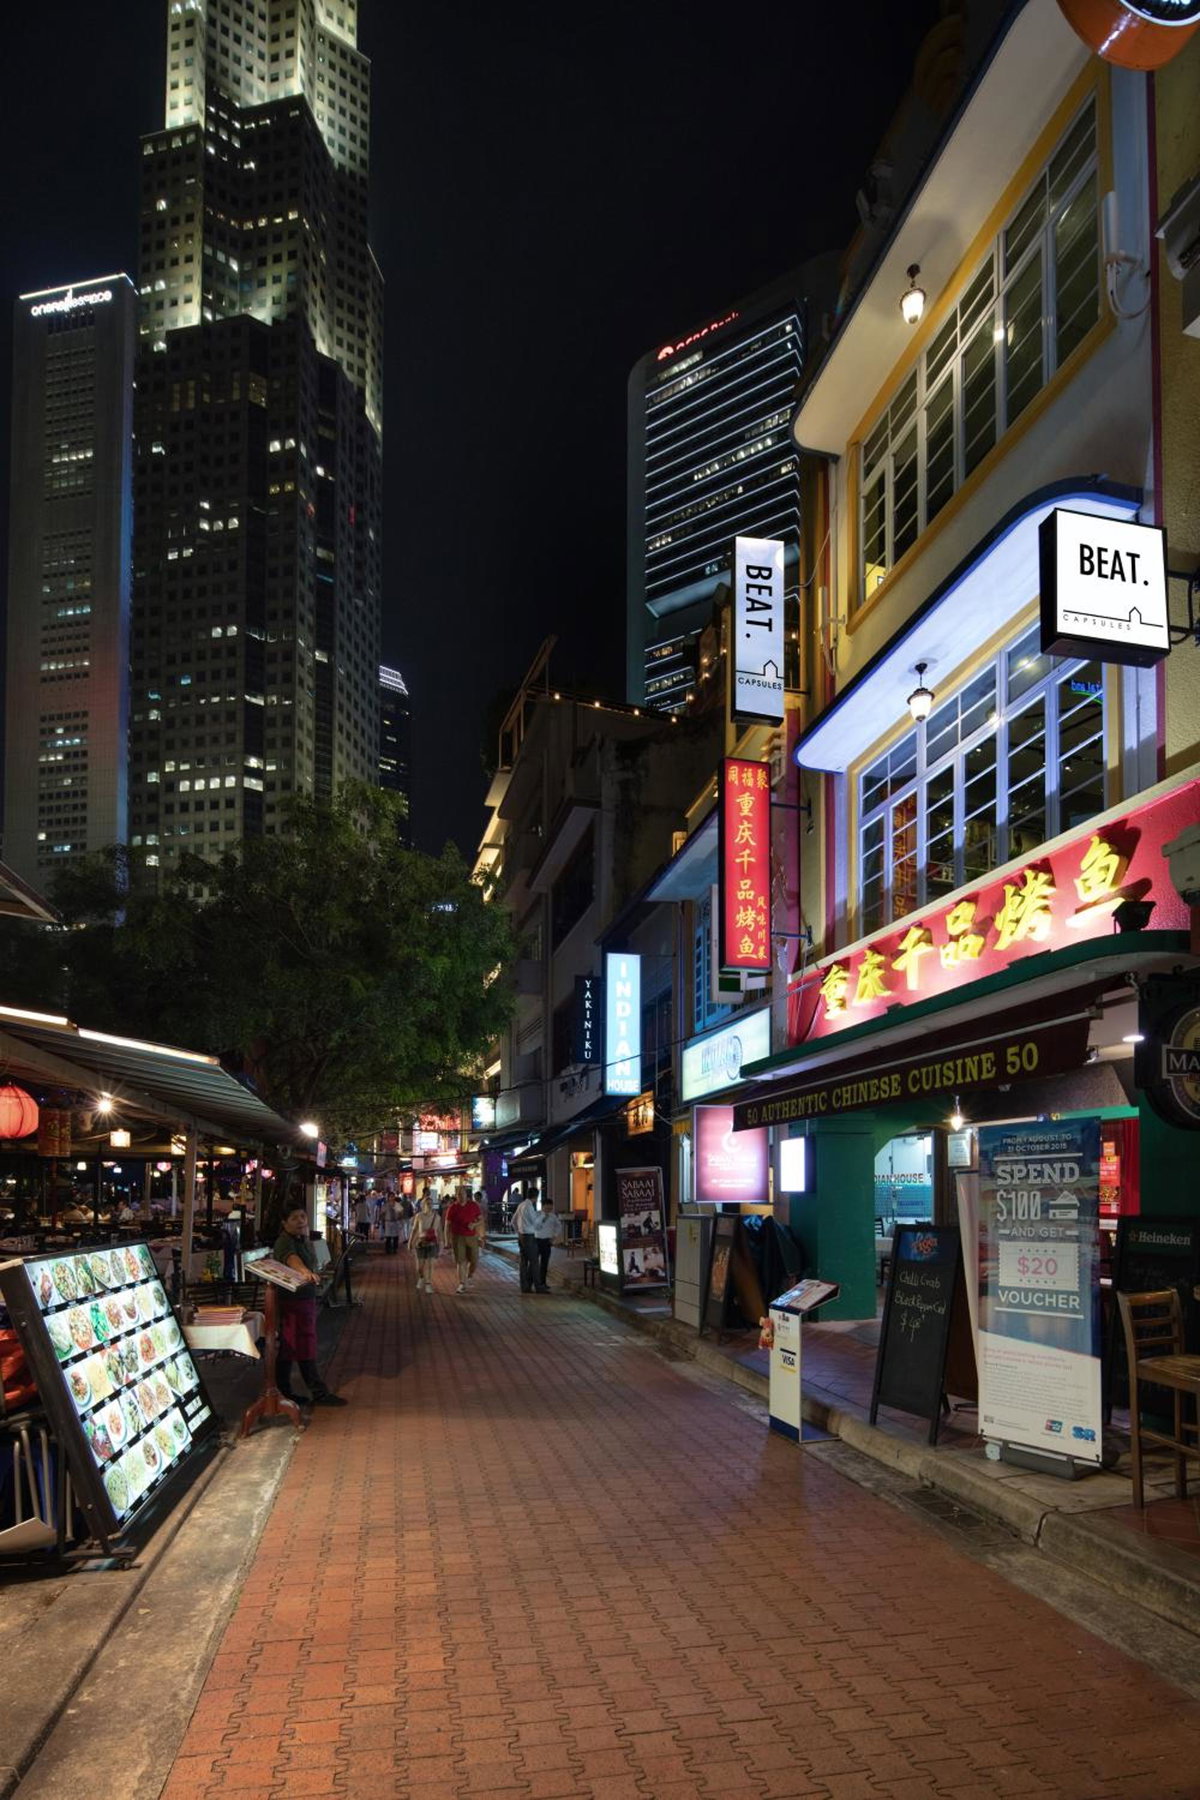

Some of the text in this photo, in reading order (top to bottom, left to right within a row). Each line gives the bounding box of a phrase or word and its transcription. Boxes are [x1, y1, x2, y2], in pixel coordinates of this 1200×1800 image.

[1079, 543, 1149, 586] BEAT.
[745, 564, 773, 639] BEAT.
[1062, 613, 1131, 631] CAPSULES
[737, 677, 782, 690] CAPSULES
[734, 792, 757, 959] 重庆千品烤鱼
[584, 980, 593, 1059] YAKINIKU
[615, 960, 632, 1076] INDIAN
[747, 1042, 1039, 1125] 50 AUTHENTIC CHINESE CUISINE 50
[996, 1162, 1080, 1185] SPEND
[996, 1190, 1041, 1222] $100
[1011, 1227, 1065, 1238] AND GET
[1138, 1231, 1191, 1246] Heineken
[1017, 1255, 1058, 1276] $20
[998, 1289, 1080, 1310] VOUCHER
